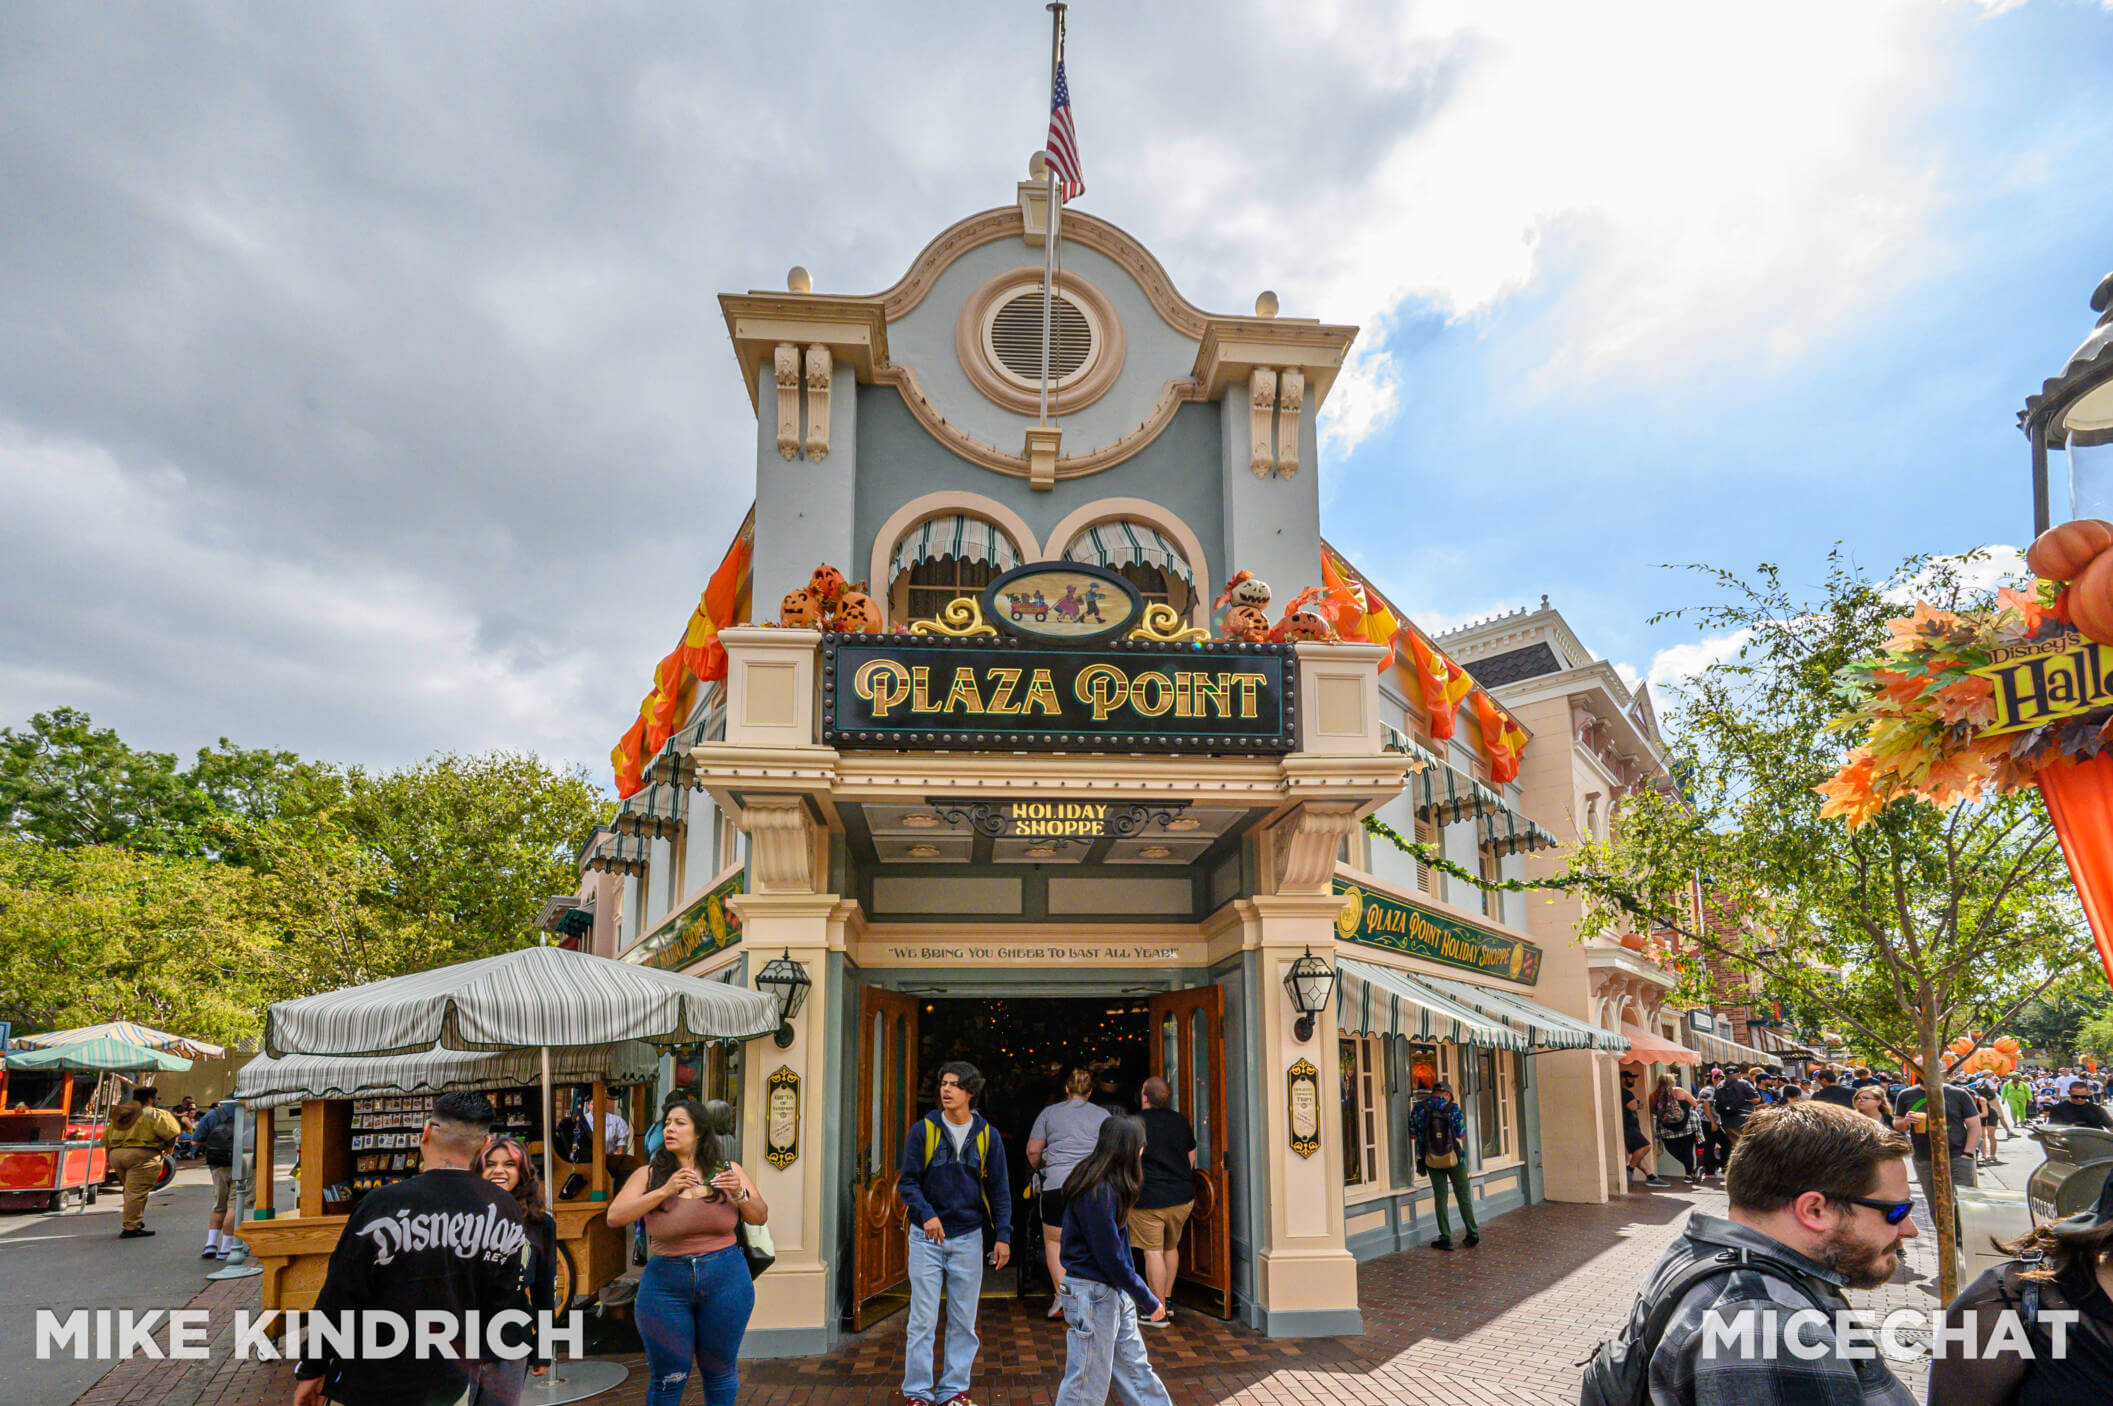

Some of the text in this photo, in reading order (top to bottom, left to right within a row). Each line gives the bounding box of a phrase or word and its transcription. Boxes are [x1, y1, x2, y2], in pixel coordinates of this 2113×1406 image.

[1992, 631, 2081, 665] Disney's
[854, 659, 1267, 721] PLAZA POINT
[1012, 803, 1108, 819] HOLIDAY
[1015, 820, 1105, 836] SHOPPE
[1366, 903, 1512, 967] PLAZA POINT HOLIDAY SHOPPE
[921, 947, 963, 959] BRING
[968, 946, 994, 959] YOU
[997, 947, 1045, 959] CHEER
[1048, 947, 1066, 959] TO
[1069, 947, 1100, 959] LAST
[1104, 947, 1131, 959] ALL
